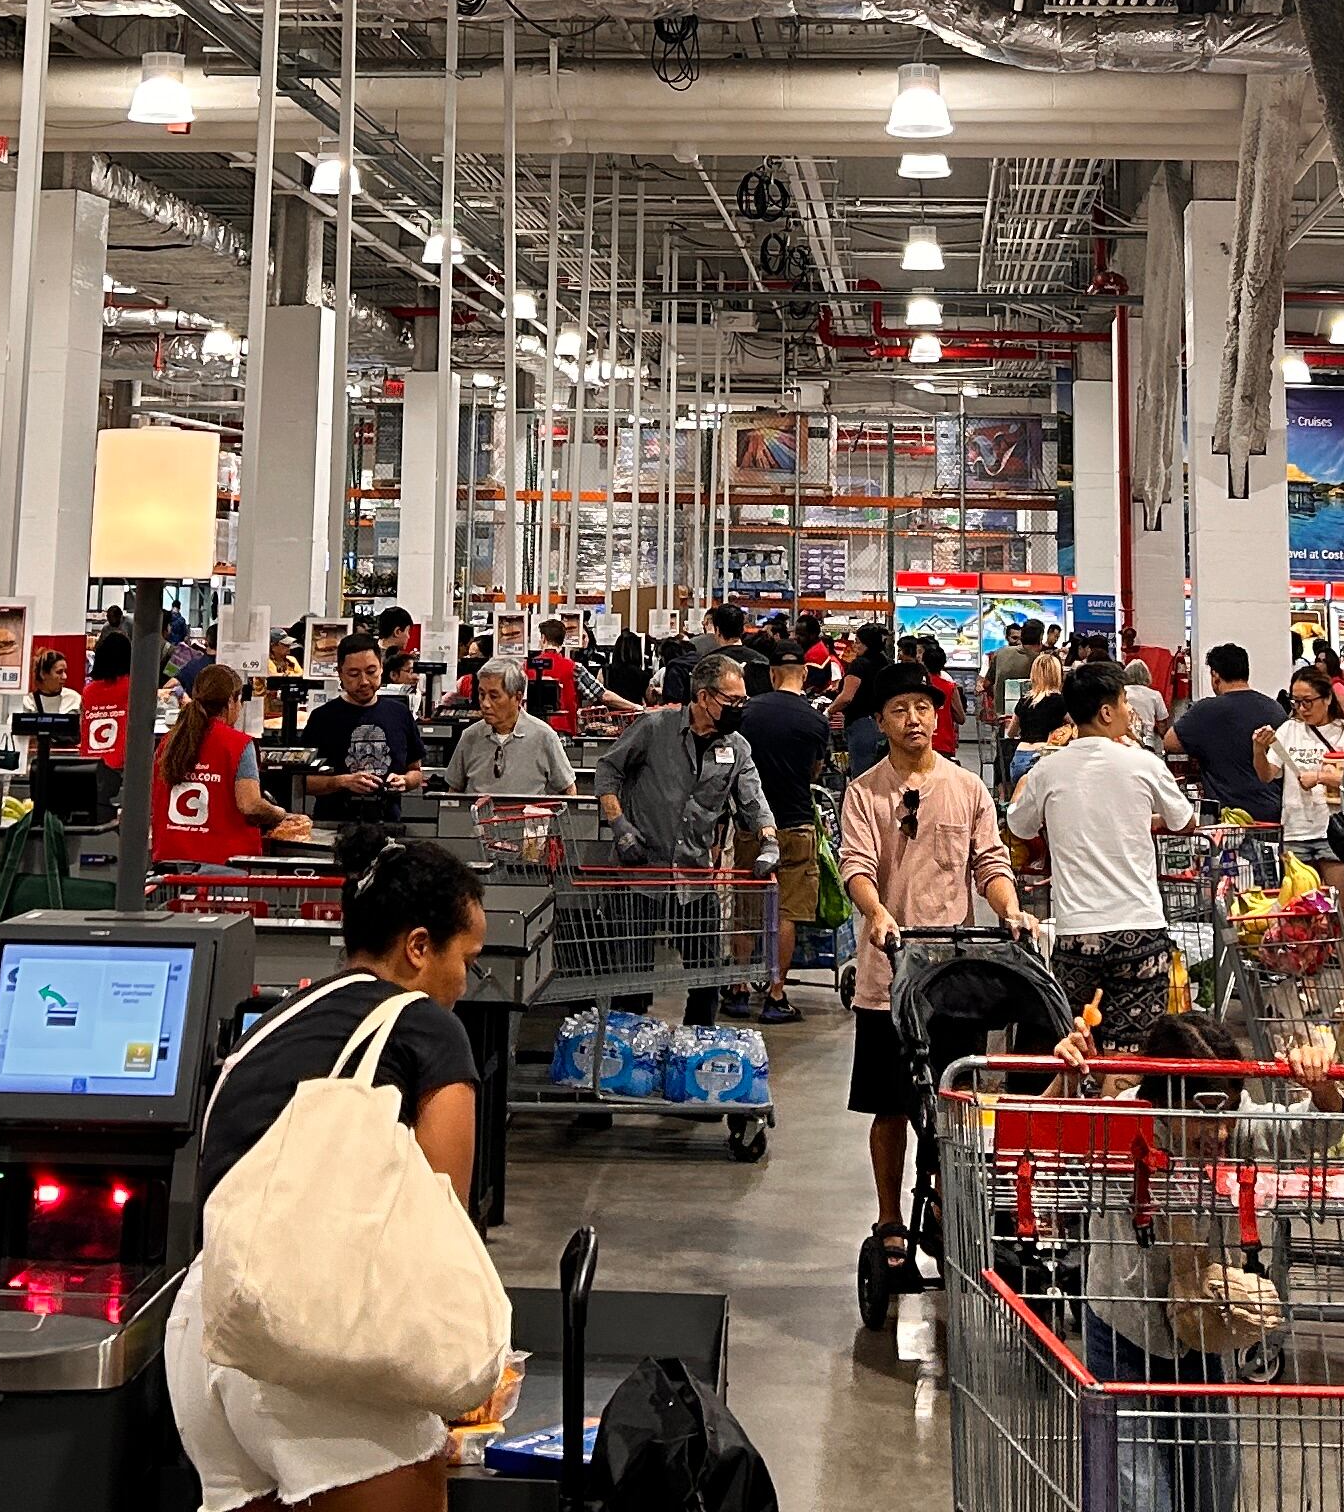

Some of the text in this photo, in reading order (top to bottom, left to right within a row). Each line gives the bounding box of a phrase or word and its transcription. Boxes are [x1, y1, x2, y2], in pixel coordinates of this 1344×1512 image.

[1298, 416, 1333, 428] Cruises
[1309, 550, 1319, 560] at
[242, 661, 260, 669] 6.99
[184, 772, 222, 783] co.com
